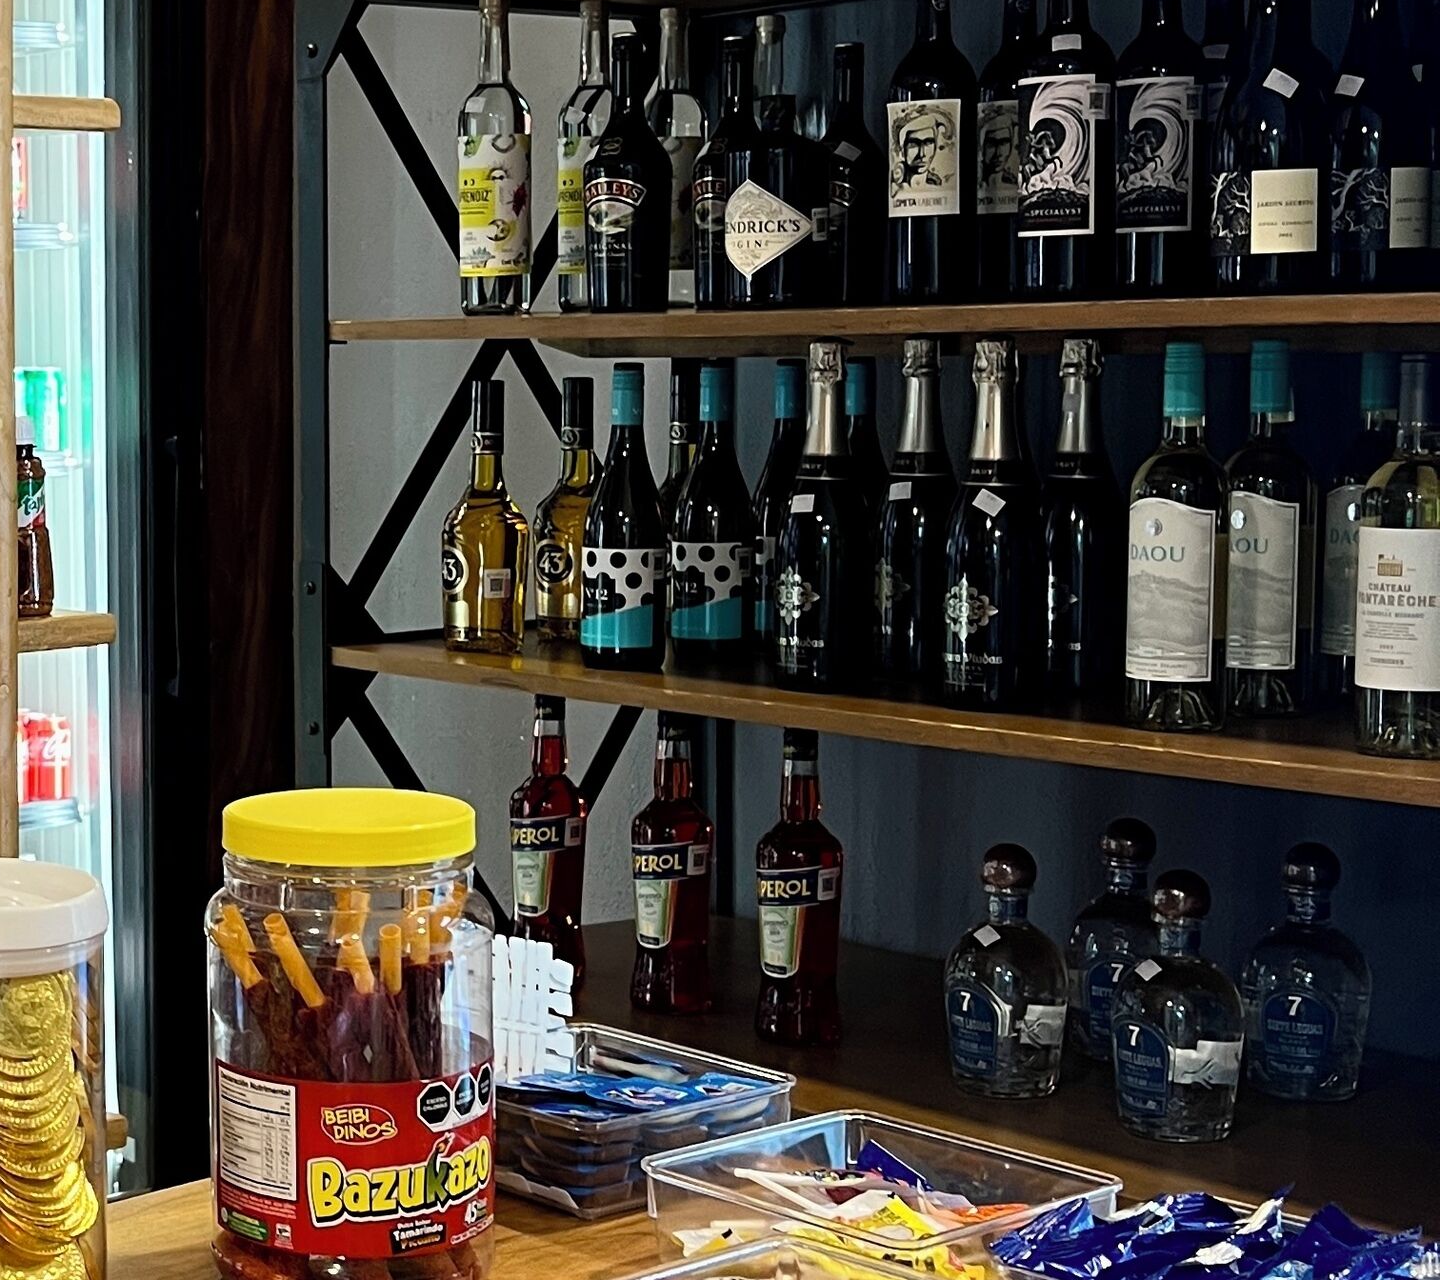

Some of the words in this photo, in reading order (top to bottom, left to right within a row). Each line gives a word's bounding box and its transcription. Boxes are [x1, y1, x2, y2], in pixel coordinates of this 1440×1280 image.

[539, 552, 564, 575] 43
[1131, 546, 1186, 563] DAOU
[512, 827, 560, 846] PEROL
[635, 854, 683, 874] PEROL
[759, 879, 811, 900] PEROL
[1111, 962, 1125, 983] 7
[959, 991, 972, 1013] 7
[1288, 996, 1303, 1017] 7
[1128, 1025, 1140, 1047] 7
[324, 1108, 371, 1126] BEIBI
[333, 1121, 397, 1140] DINOS
[393, 1222, 444, 1242] Tamarindo
